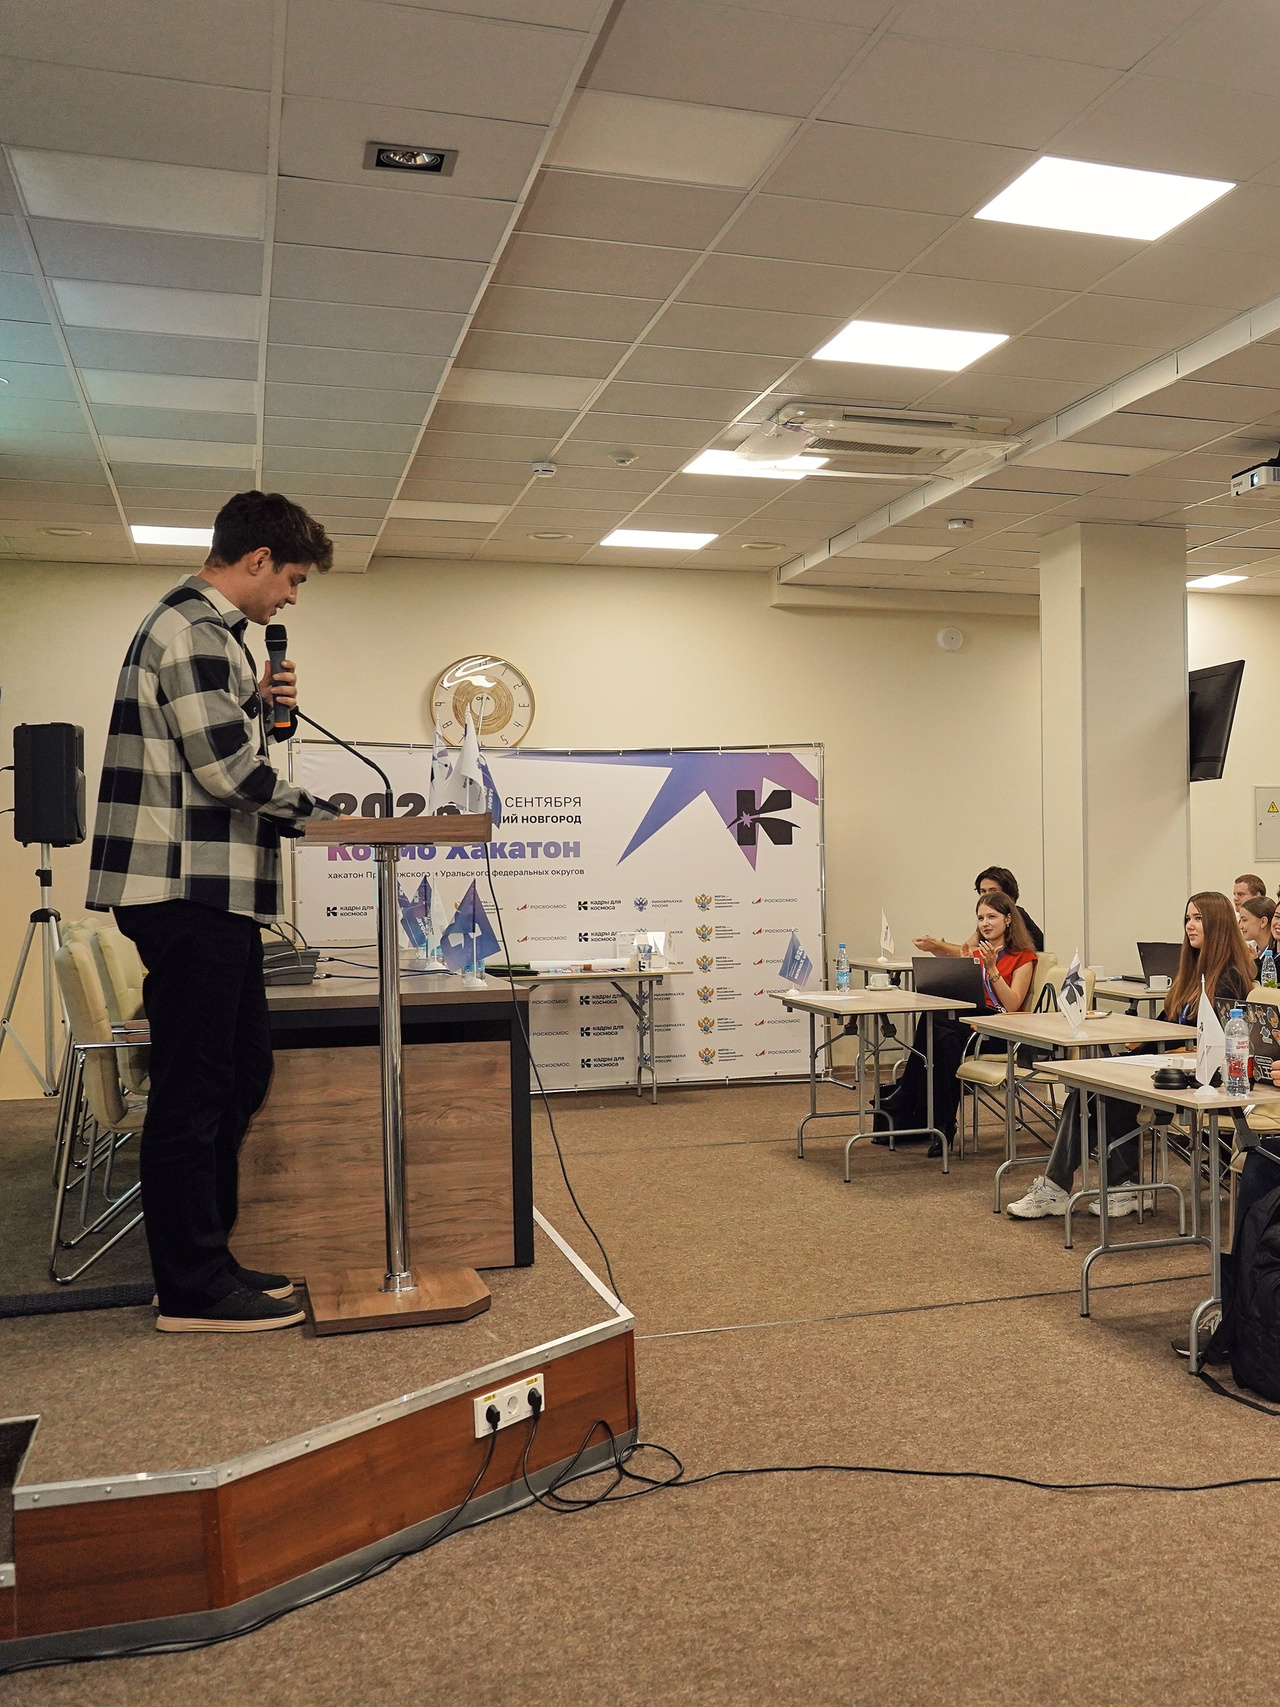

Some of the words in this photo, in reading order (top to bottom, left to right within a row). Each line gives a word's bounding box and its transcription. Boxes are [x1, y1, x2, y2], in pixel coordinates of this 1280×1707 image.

[505, 796, 582, 808] СЕНТЯБРЯ
[521, 815, 582, 824] НОВГОРОД
[328, 844, 436, 861] Комо
[446, 841, 581, 860] Хакатон
[327, 872, 364, 880] хакатон
[366, 871, 431, 880] Пржского
[440, 869, 489, 879] Уральского
[491, 868, 549, 877] федеральных
[551, 868, 585, 876] округов
